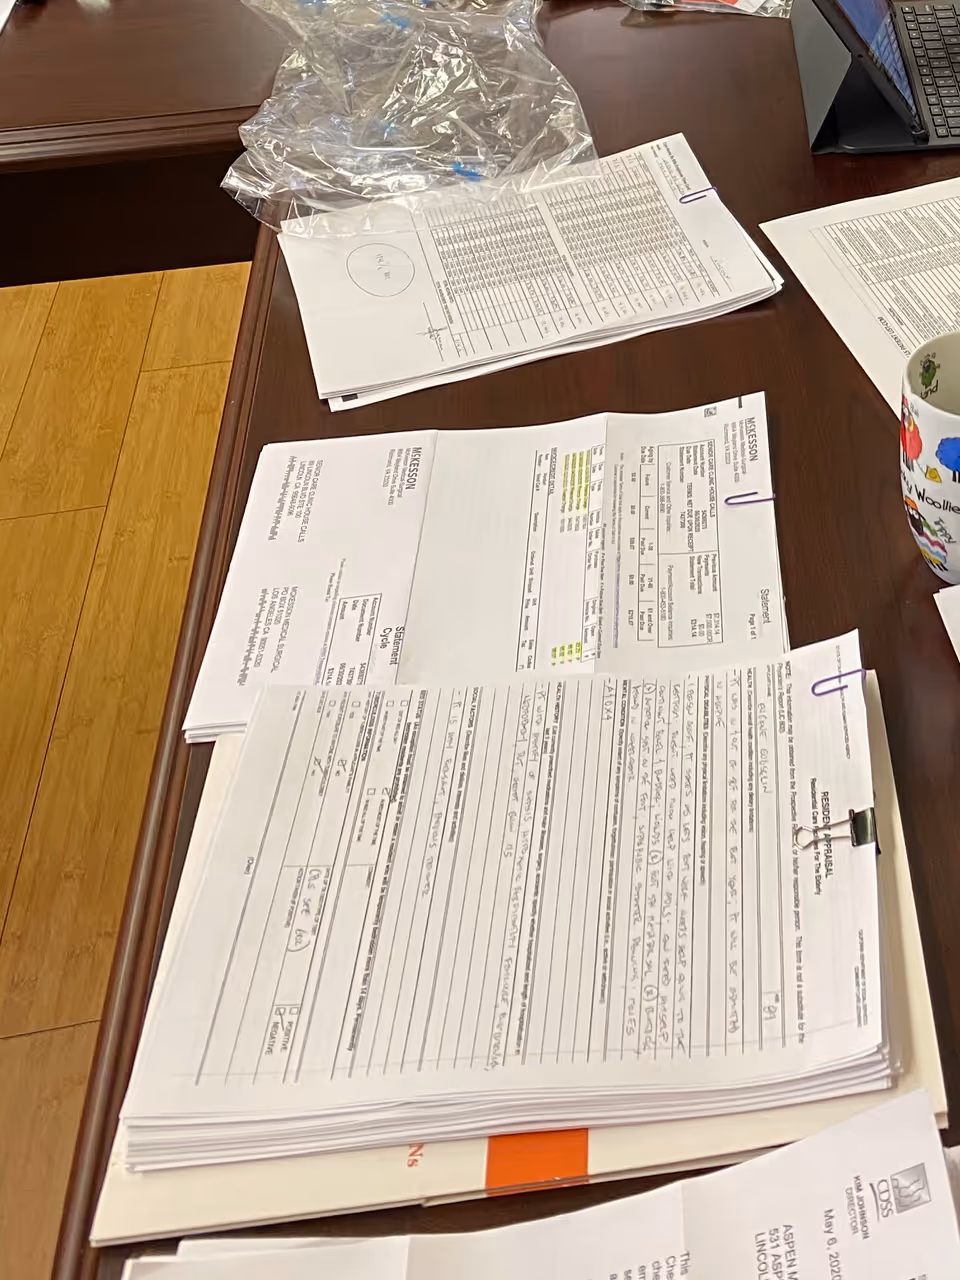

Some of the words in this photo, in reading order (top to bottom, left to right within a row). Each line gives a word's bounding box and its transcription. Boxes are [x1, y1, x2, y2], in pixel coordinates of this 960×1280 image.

[296, 460, 307, 481] LINCOLN
[293, 481, 302, 490] CA
[297, 525, 308, 543] CALLS
[264, 600, 277, 627] ANGELES
[285, 586, 299, 618] MCKESSON
[760, 588, 772, 624] Statement
[748, 613, 756, 626] Page
[379, 627, 393, 649] Cycle
[389, 626, 405, 666] Statement
[810, 777, 818, 810] Residential
[811, 810, 819, 825] Care
[813, 851, 821, 862] For
[814, 875, 822, 896] Elderly
[264, 1021, 280, 1055] NEGATIVE
[853, 1175, 863, 1194] KIM
[823, 1208, 835, 1234] May
[845, 1187, 865, 1235] DIRECTOR
[850, 1195, 870, 1240] JOHNSON
[768, 1227, 781, 1250] 531
[776, 1224, 797, 1269] ASPEN
[826, 1237, 838, 1251] 6,
[680, 1250, 690, 1276] This
[754, 1232, 776, 1278] LINCOL
[770, 1253, 784, 1278] ASP
